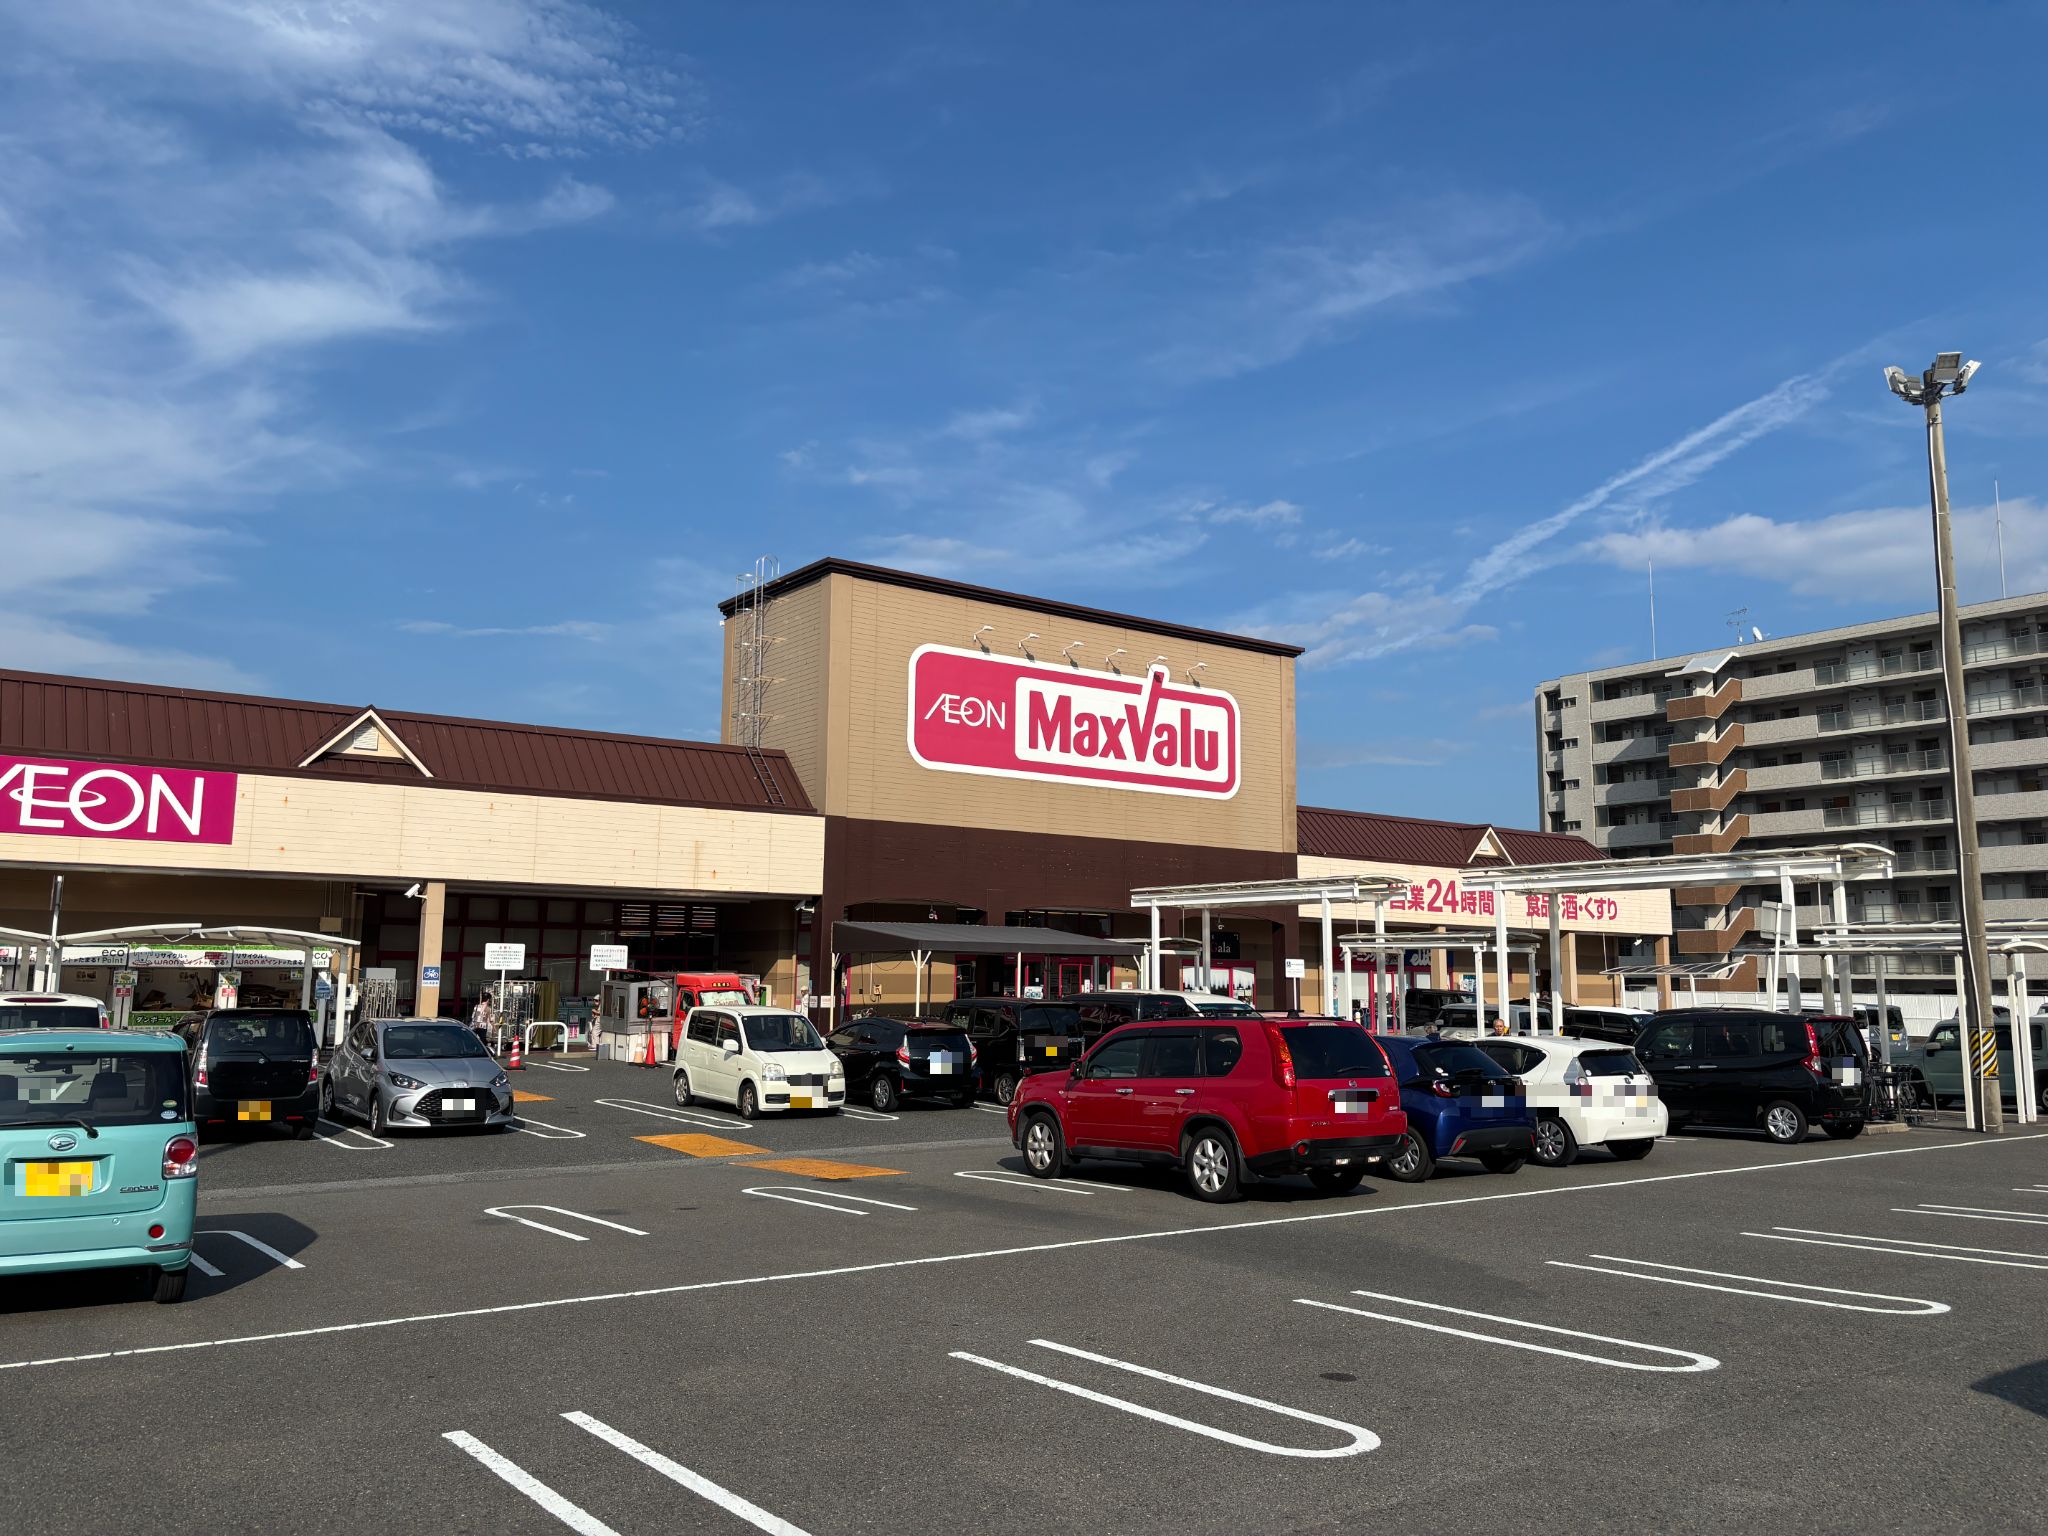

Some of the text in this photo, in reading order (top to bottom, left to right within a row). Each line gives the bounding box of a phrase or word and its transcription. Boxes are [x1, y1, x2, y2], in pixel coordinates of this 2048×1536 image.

[1028, 671, 1220, 772] MaxValu
[1525, 892, 1618, 921] 食品酒・くすり
[101, 949, 125, 957] eco
